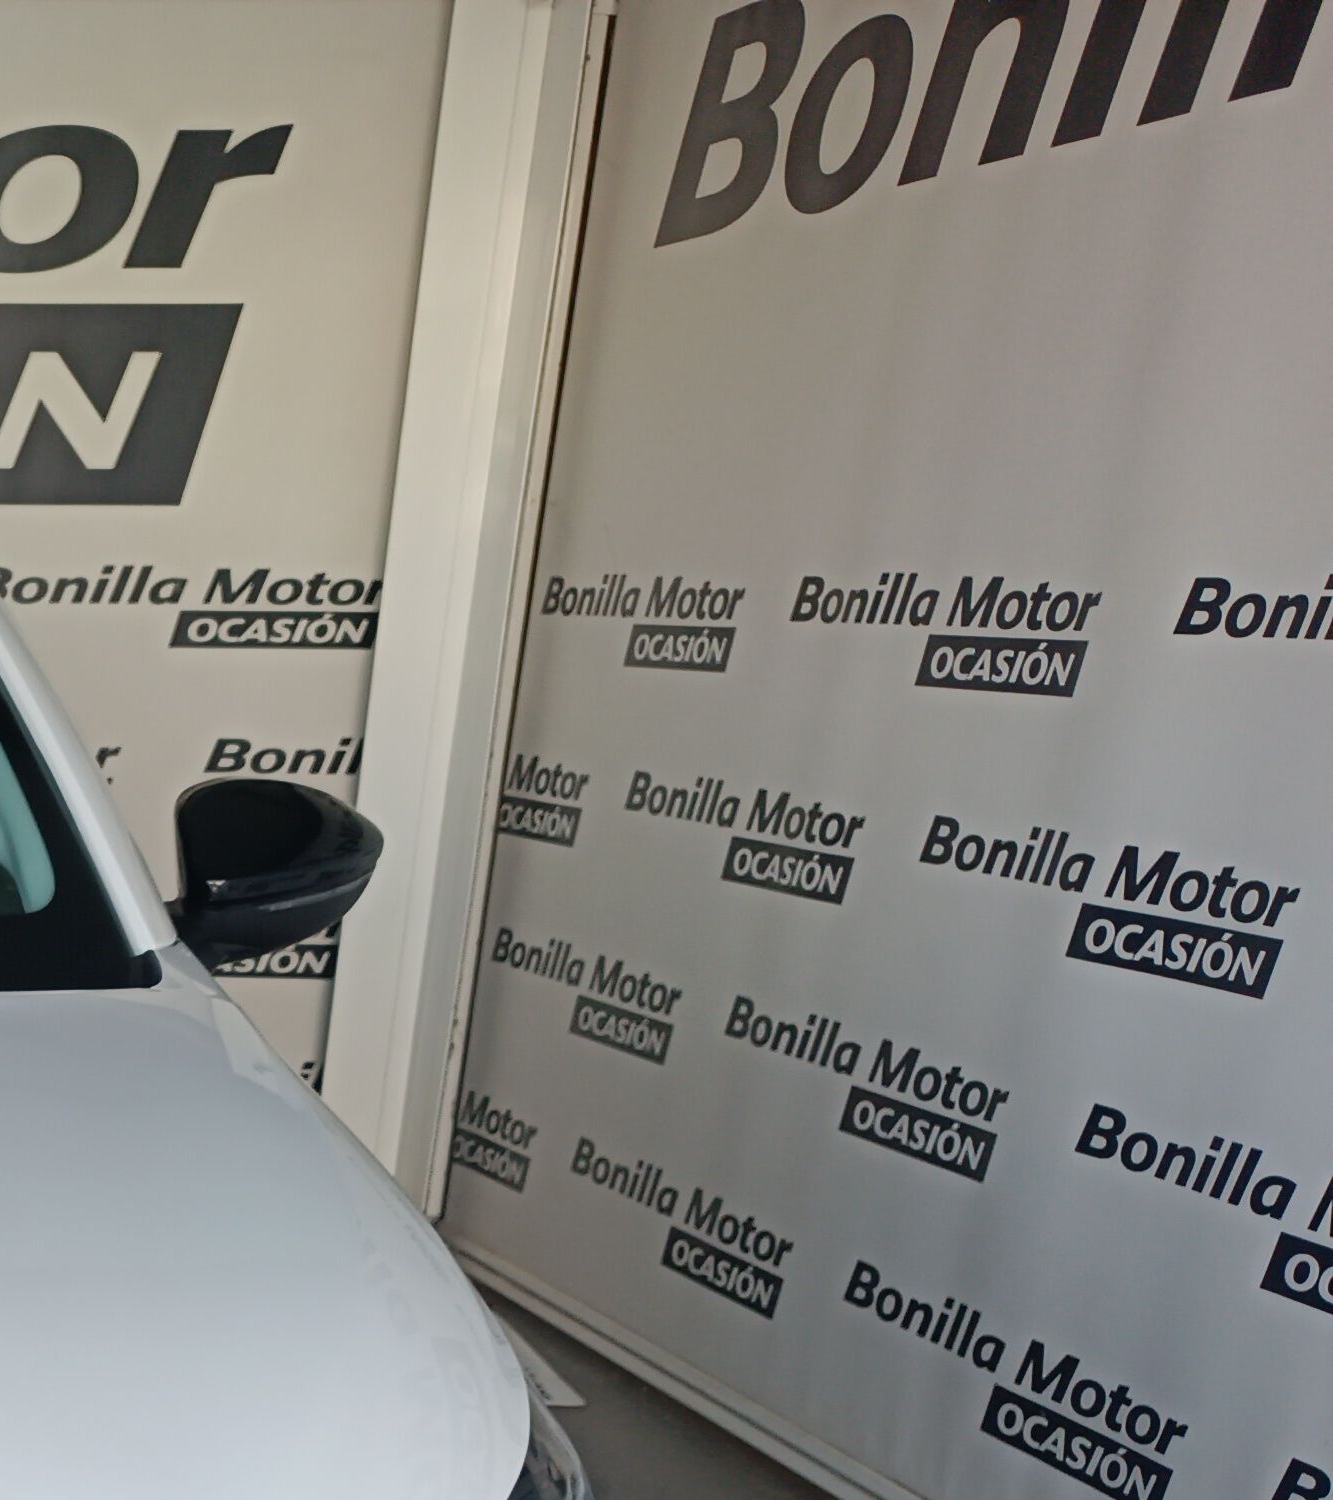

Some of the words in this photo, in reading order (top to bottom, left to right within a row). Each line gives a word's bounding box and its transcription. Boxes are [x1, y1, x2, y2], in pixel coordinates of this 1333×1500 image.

[202, 568, 382, 606] Motor
[540, 574, 641, 617] Bonilla
[645, 576, 745, 620] Motor
[789, 572, 939, 626] Bonilla
[946, 576, 1102, 633] Motor
[1173, 574, 1333, 640] Boni
[187, 614, 368, 643] OCASIÓN
[634, 628, 727, 664] OCASIÓN
[930, 641, 1076, 686] OCASIÓN
[204, 738, 363, 774] Bonil
[508, 754, 590, 801] Motor
[624, 771, 740, 830] Bonilla
[746, 787, 865, 849] Motor
[733, 848, 844, 896] OCASIÓN
[919, 814, 1095, 894] Bonilla
[1105, 844, 1301, 929] Motor
[491, 925, 585, 987] Bonilla
[588, 955, 683, 1016] Motor
[1085, 918, 1268, 987] OCASIÓN
[577, 1004, 666, 1056] OCASIÓN
[724, 996, 860, 1076] Bonilla
[867, 1038, 1010, 1123] Motor
[460, 1090, 537, 1149] Motor
[853, 1100, 985, 1173] OCASIÓN
[1074, 1103, 1297, 1220] Bonilla
[570, 1138, 678, 1215] Bonilla
[684, 1187, 794, 1268] Motor
[672, 1237, 775, 1309] OCASIÓN
[843, 1260, 1005, 1371] Bonilla
[1015, 1339, 1188, 1455] Motor
